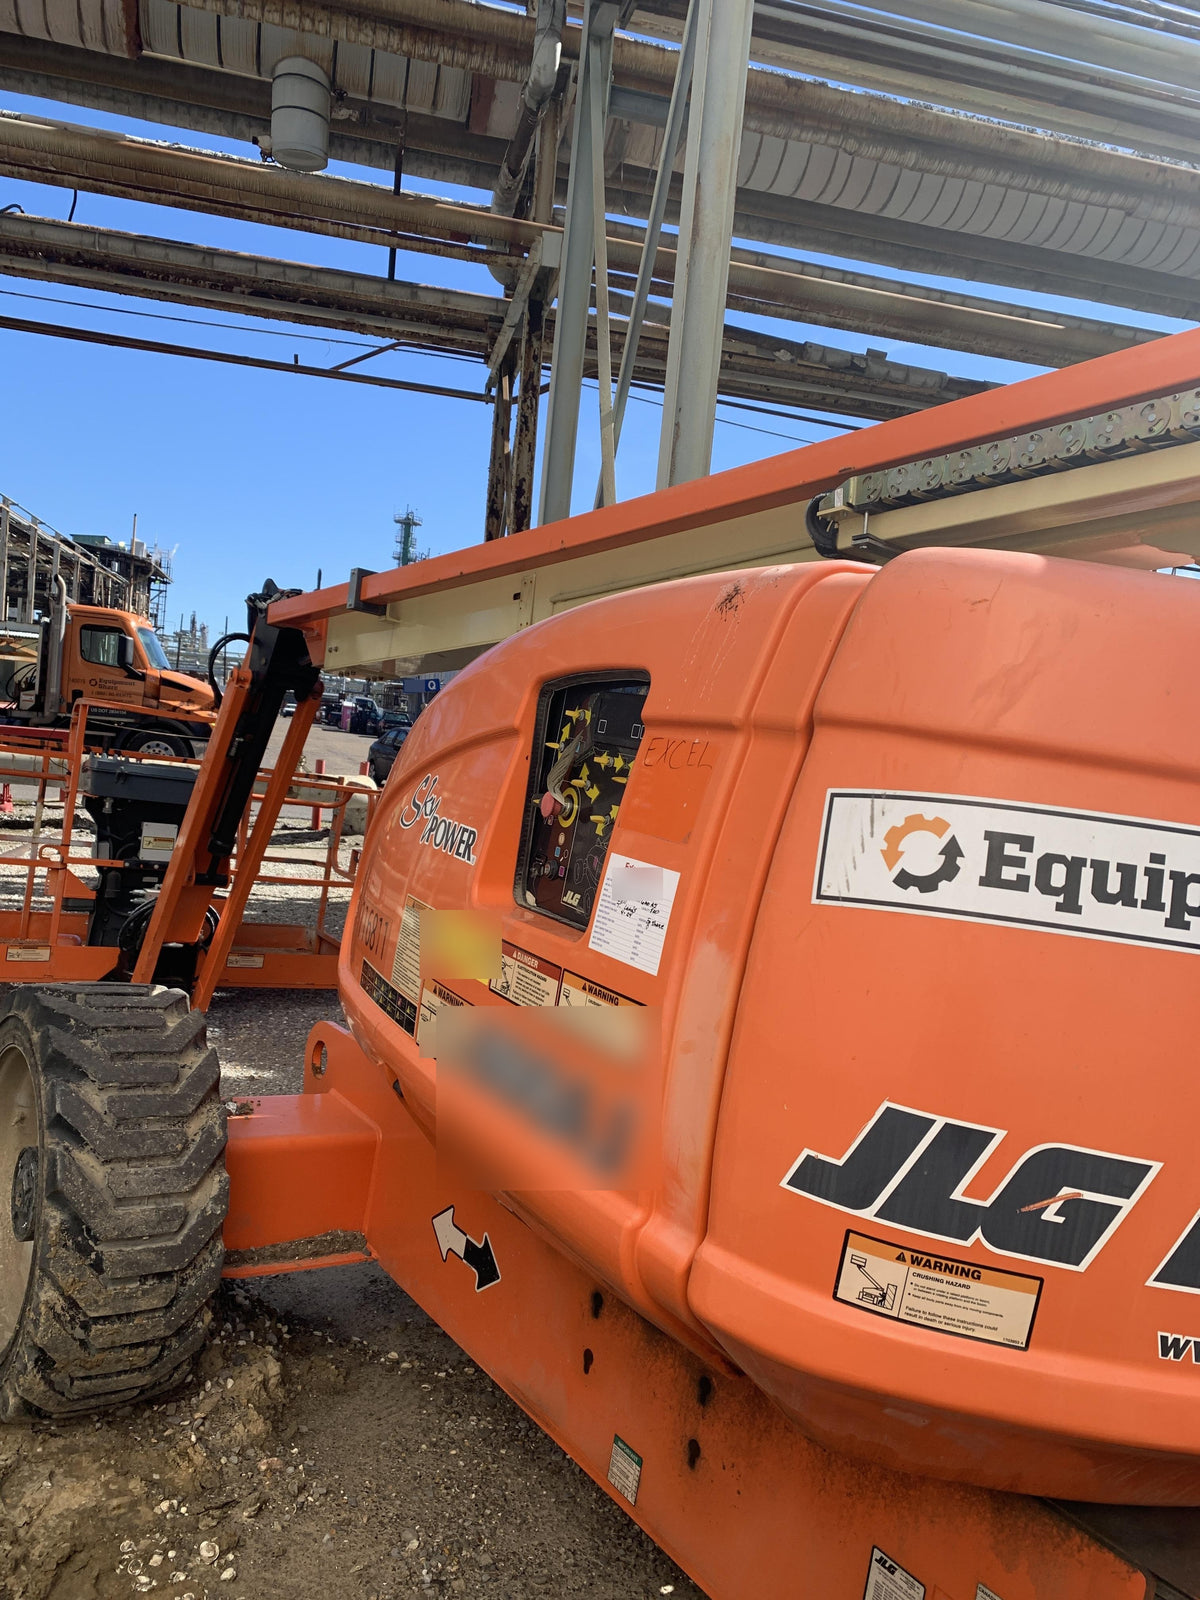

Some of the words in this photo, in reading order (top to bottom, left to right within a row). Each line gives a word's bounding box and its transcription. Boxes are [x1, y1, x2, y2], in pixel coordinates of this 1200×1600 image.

[428, 680, 436, 690] Q
[644, 737, 713, 770] EXCEL
[400, 774, 441, 843] Sky
[427, 815, 478, 864] POWER
[978, 829, 1200, 931] Equip
[562, 890, 581, 906] JLG
[517, 951, 539, 969] DANGER
[587, 984, 619, 1006] WARNING
[780, 1101, 1165, 1273] JLG
[910, 1254, 982, 1281] WARNING
[912, 1272, 944, 1284] CRUSHING
[945, 1279, 971, 1290] HAZARD
[1157, 1331, 1200, 1365] w
[874, 1555, 899, 1576] JLG
